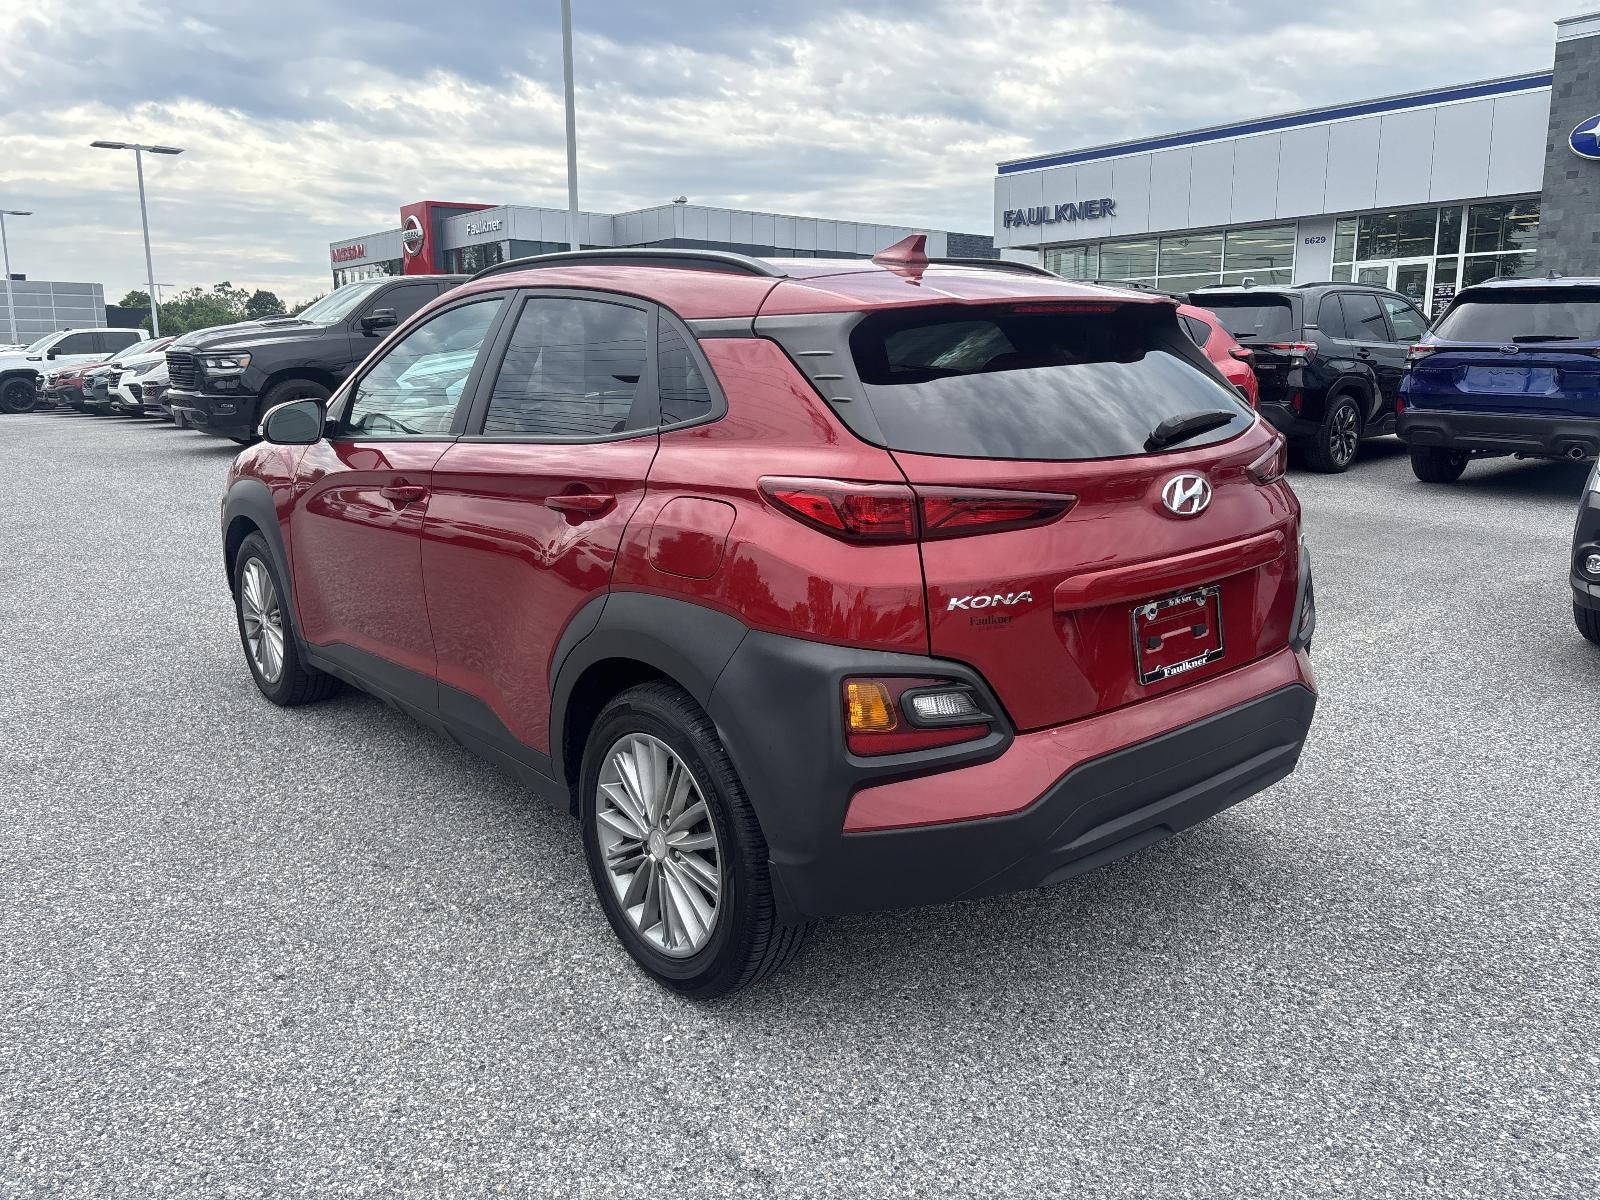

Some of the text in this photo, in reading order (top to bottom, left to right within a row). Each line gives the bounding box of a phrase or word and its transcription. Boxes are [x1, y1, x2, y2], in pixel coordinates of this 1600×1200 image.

[1003, 198, 1116, 228] FAULKNER
[466, 218, 502, 236] Faulkner
[1304, 235, 1326, 246] 6629
[947, 590, 1033, 611] KONA
[1163, 656, 1208, 677] Faulkner
